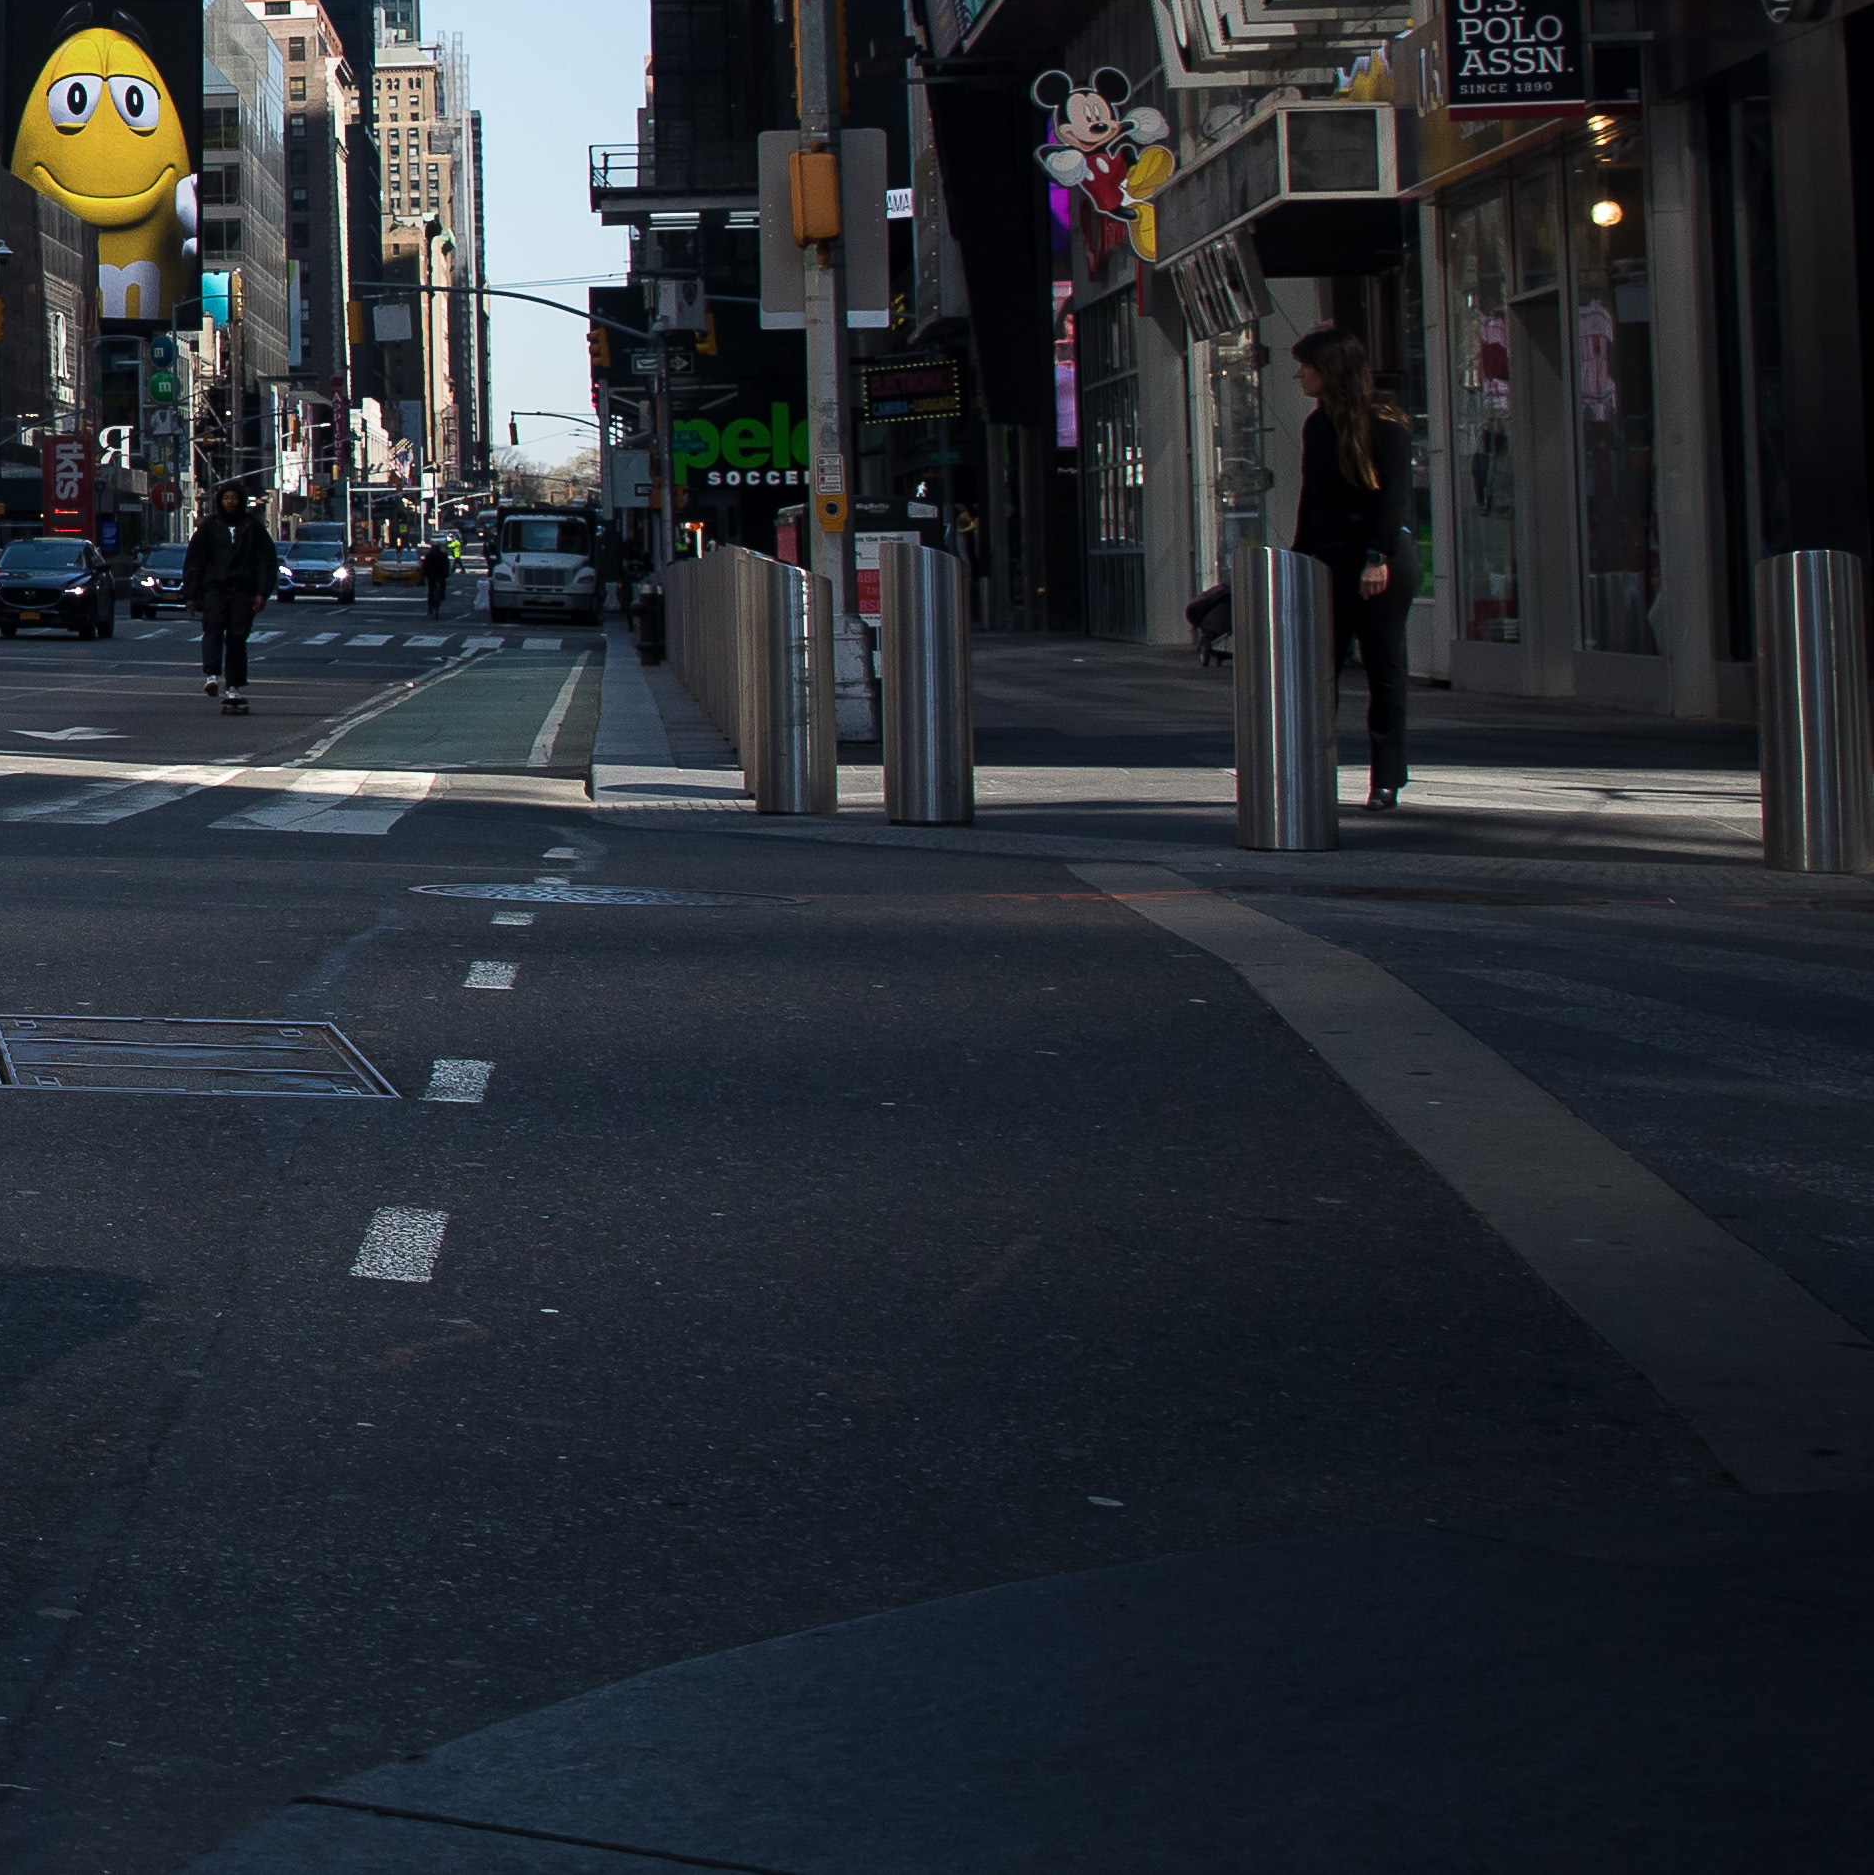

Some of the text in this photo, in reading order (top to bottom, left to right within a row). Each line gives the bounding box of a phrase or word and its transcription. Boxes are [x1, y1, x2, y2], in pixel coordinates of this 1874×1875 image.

[1456, 14, 1564, 45] POLO
[1458, 45, 1575, 77] ASSN.
[1459, 81, 1554, 95] SINCE 1890
[55, 440, 85, 501] tkts
[707, 470, 810, 486] SOCCE
